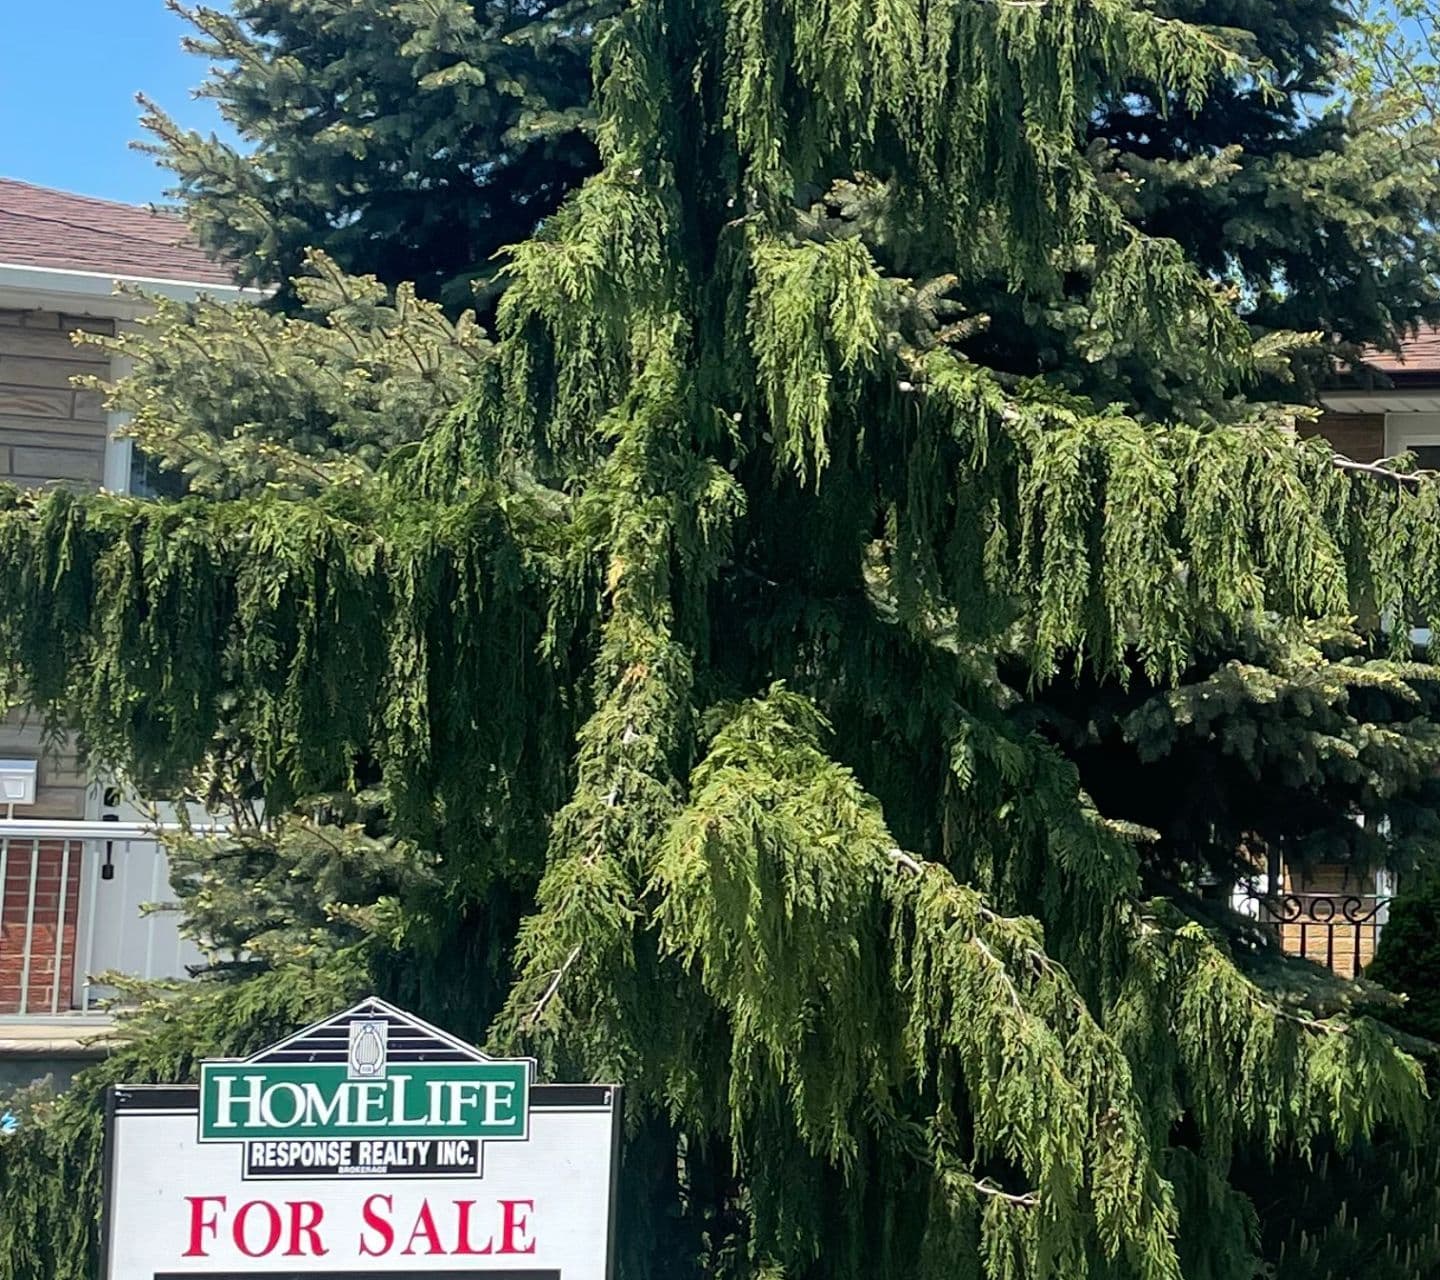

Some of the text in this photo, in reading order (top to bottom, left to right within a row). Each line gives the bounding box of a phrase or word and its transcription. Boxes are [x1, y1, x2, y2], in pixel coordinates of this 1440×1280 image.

[251, 1140, 475, 1166] RESPONSE REALTY INC.
[182, 1193, 537, 1257] FOR SALE
